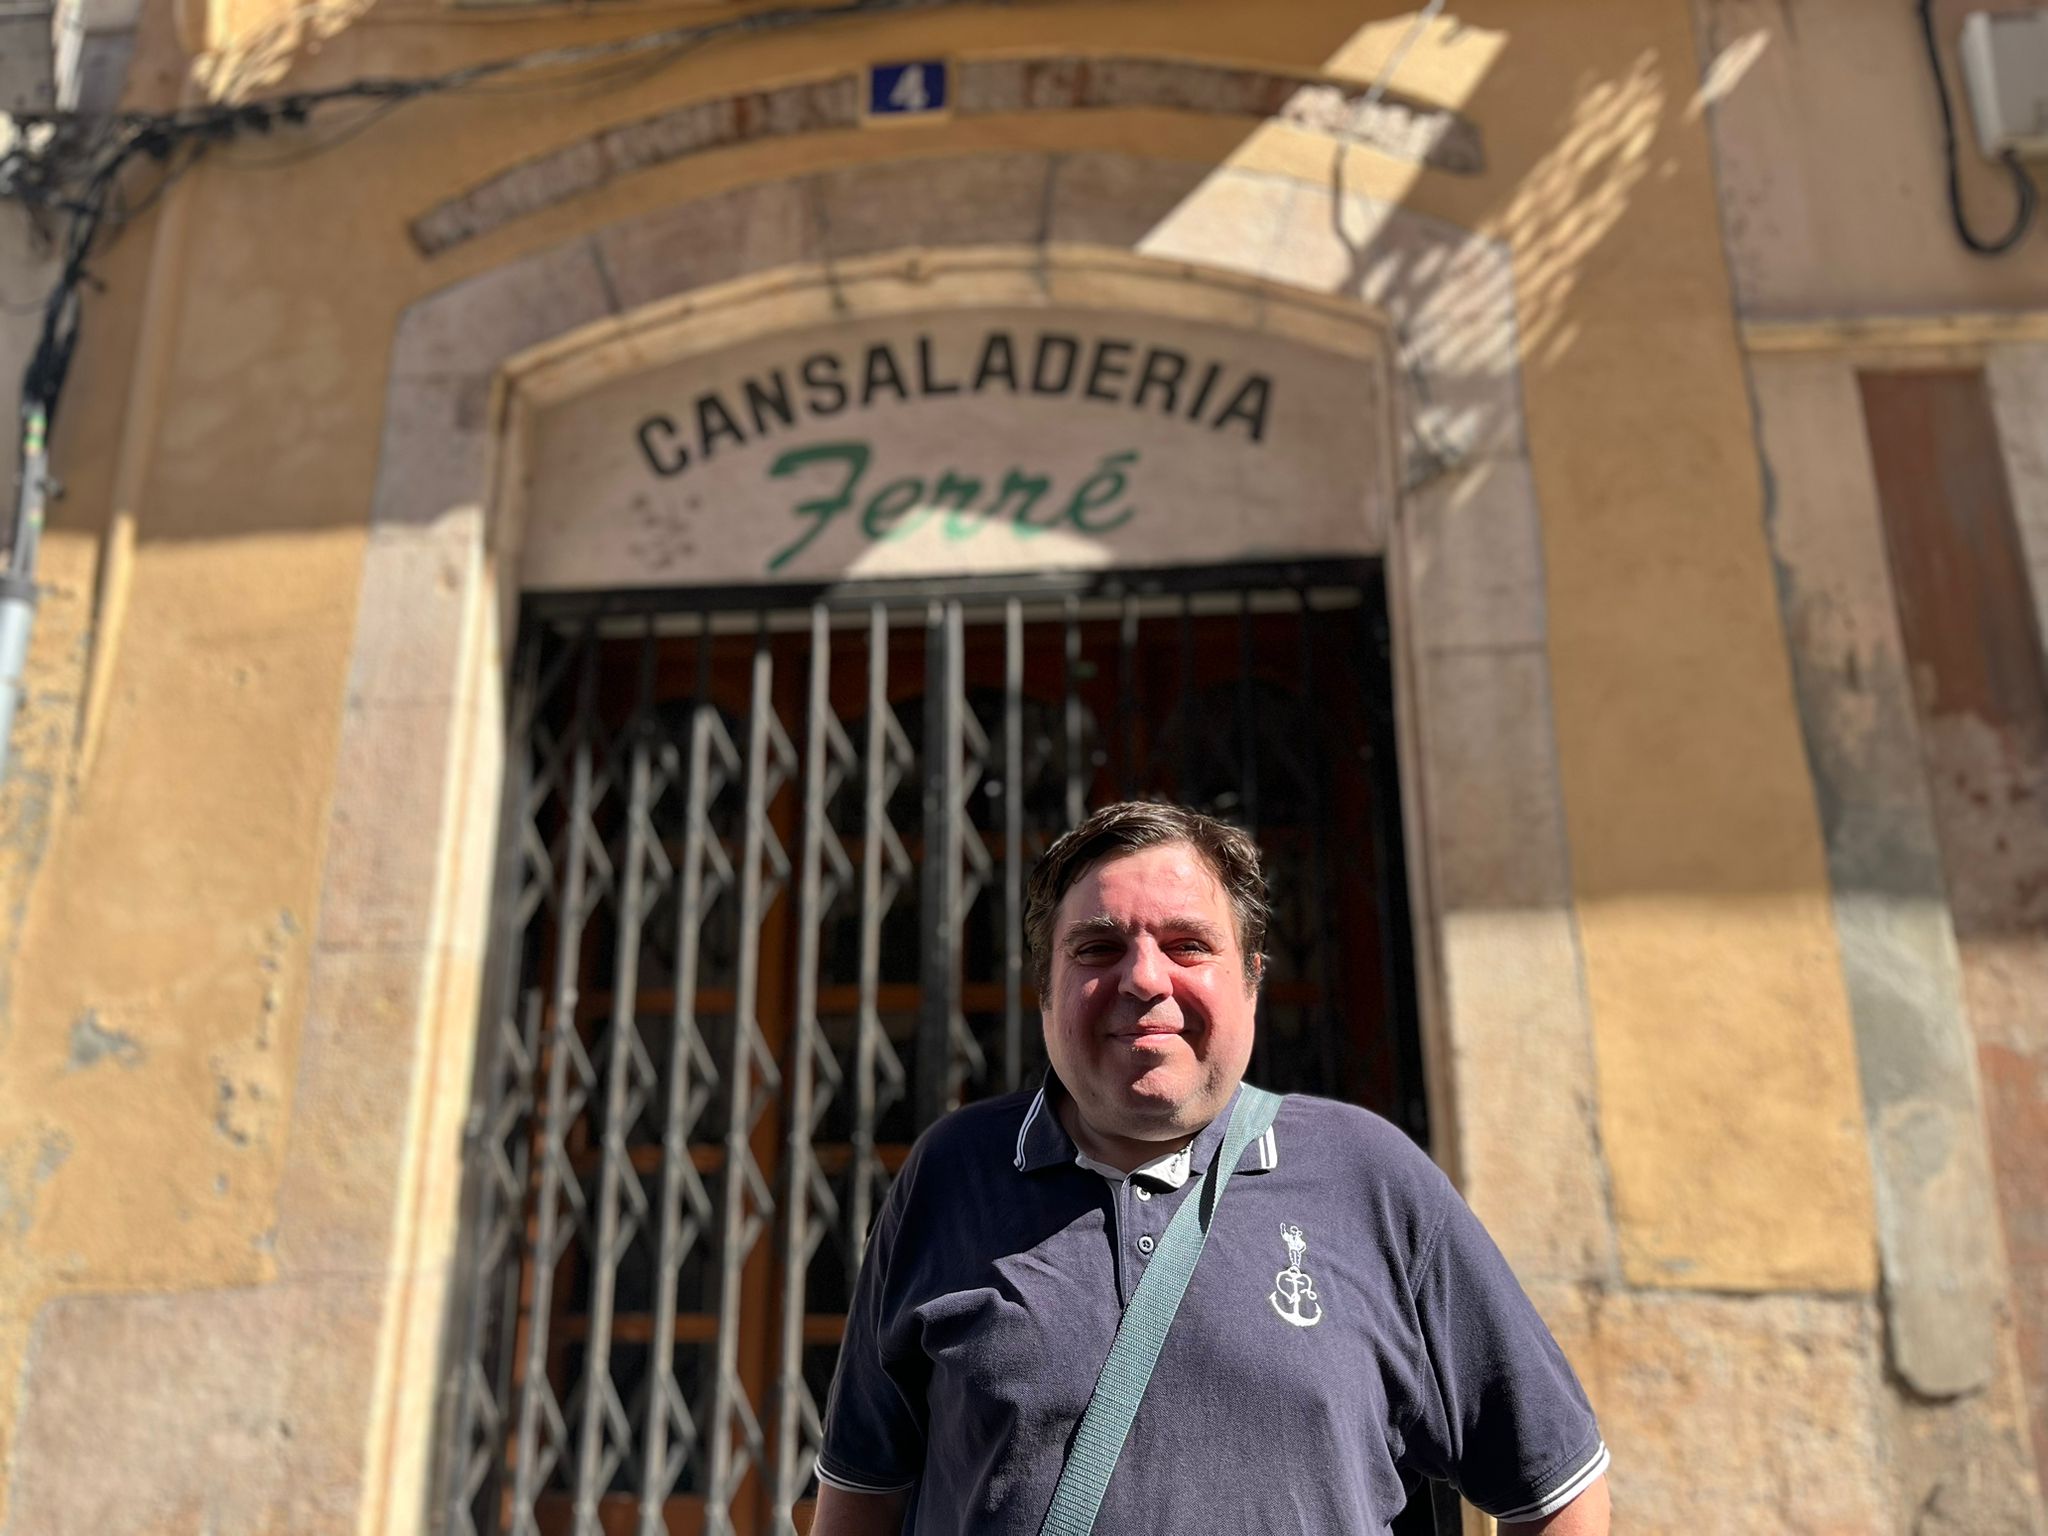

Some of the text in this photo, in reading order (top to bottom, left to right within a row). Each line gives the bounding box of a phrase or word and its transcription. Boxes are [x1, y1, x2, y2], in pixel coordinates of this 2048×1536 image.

[888, 63, 930, 111] 4
[635, 331, 1275, 480] CANSALADERIA
[767, 440, 1140, 573] Ferré
